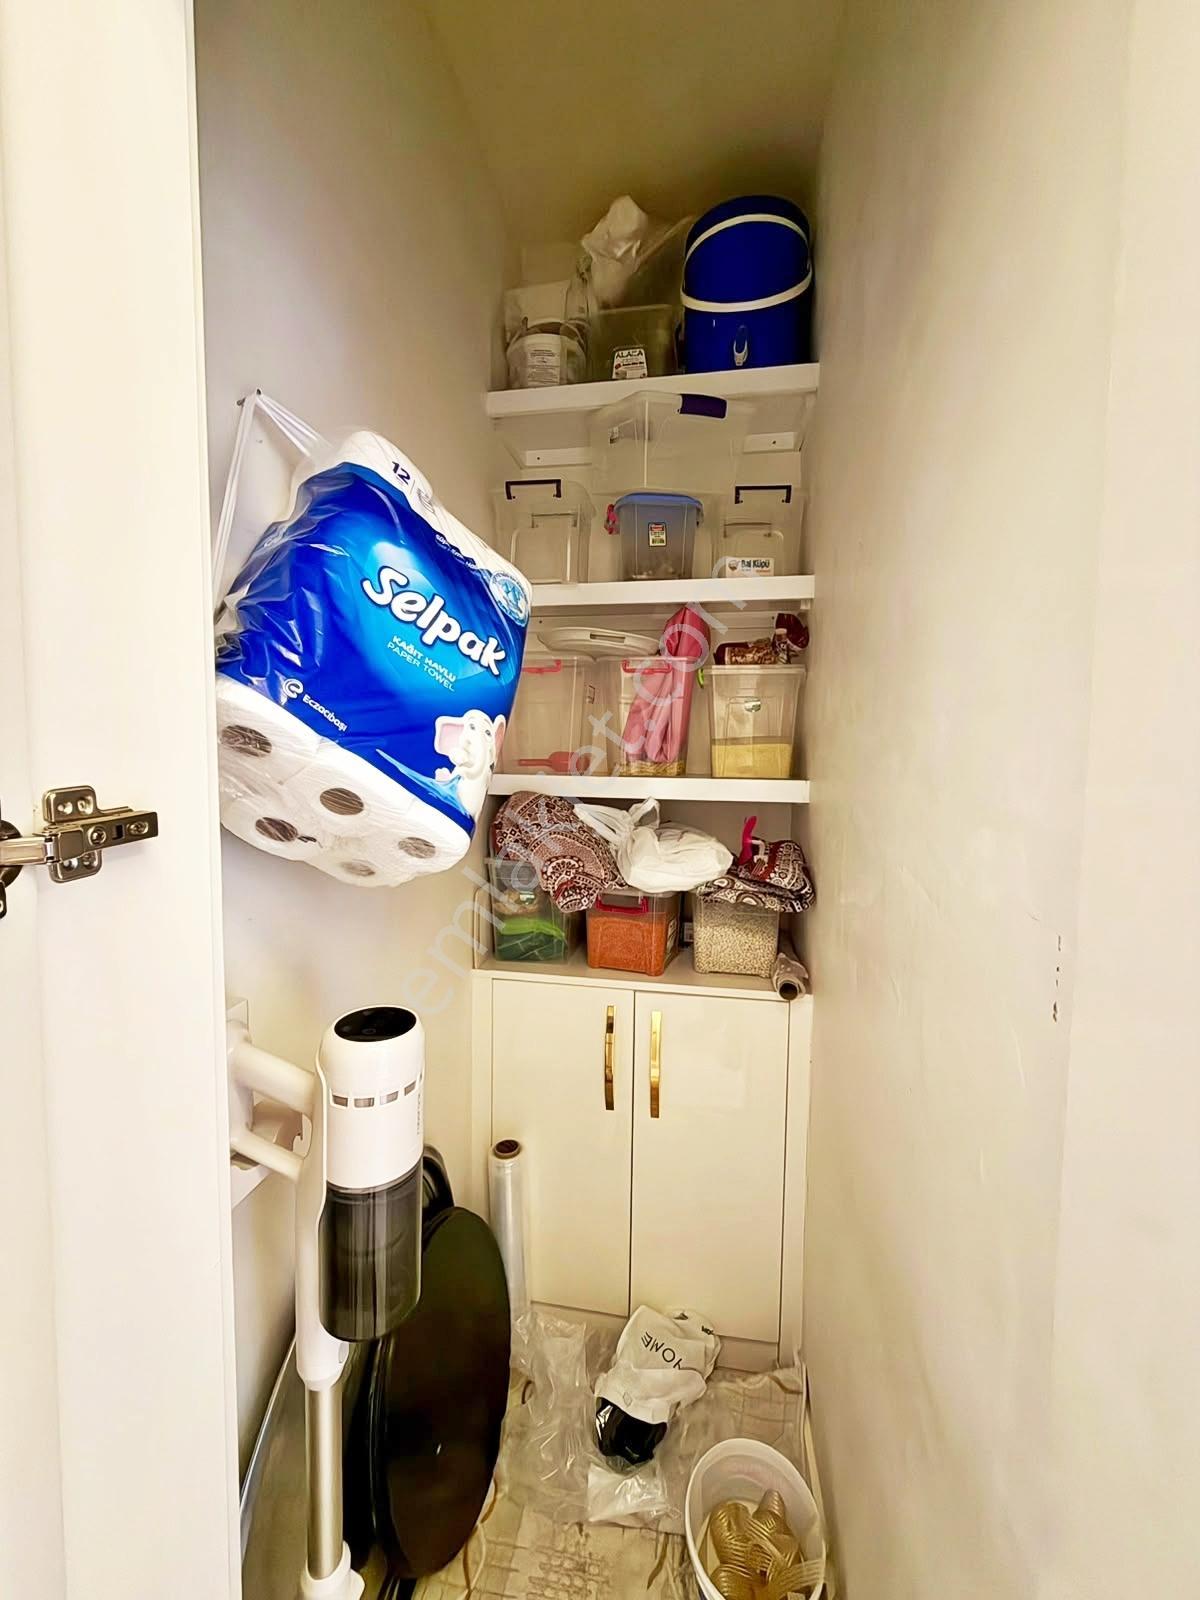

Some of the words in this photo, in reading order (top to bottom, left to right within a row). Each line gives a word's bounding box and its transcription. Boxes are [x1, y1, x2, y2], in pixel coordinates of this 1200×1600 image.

[392, 461, 411, 485] 12
[362, 566, 506, 676] Selpak
[387, 641, 421, 668] PAPER
[423, 663, 456, 692] TOWEL
[392, 635, 424, 660] KAĞIT
[424, 657, 457, 683] HAVLU
[302, 694, 347, 731] Eczacıbaşı
